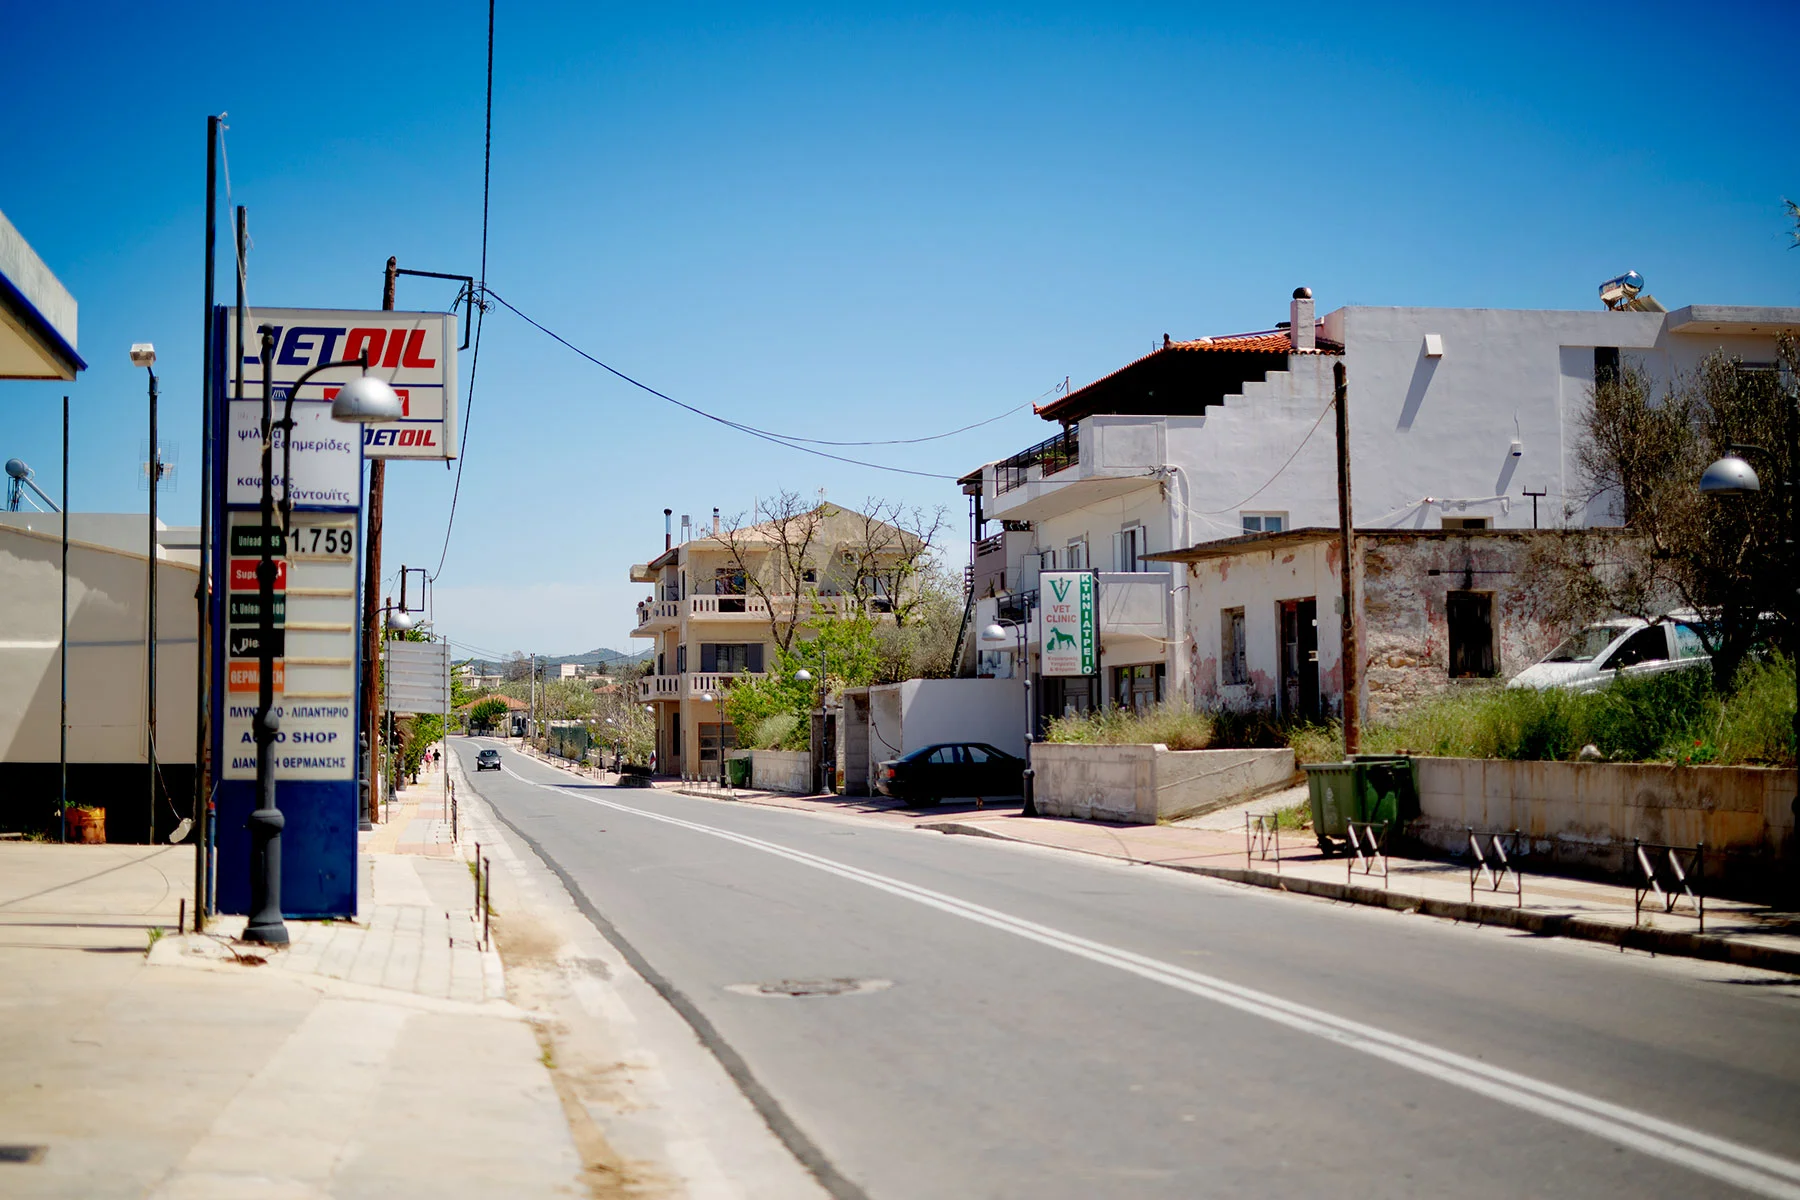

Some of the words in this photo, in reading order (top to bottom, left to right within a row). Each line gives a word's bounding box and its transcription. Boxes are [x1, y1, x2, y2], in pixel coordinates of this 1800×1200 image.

[290, 528, 353, 554] 1.759
[1052, 604, 1071, 613] VET
[1046, 614, 1077, 623] CLINIC
[1081, 574, 1092, 674] ΚΤΗΝΙΑΤΡΕΙΟ
[292, 732, 338, 743] SHOP
[283, 757, 346, 769] ΘΕΡΜΑΝΣΗΣ
